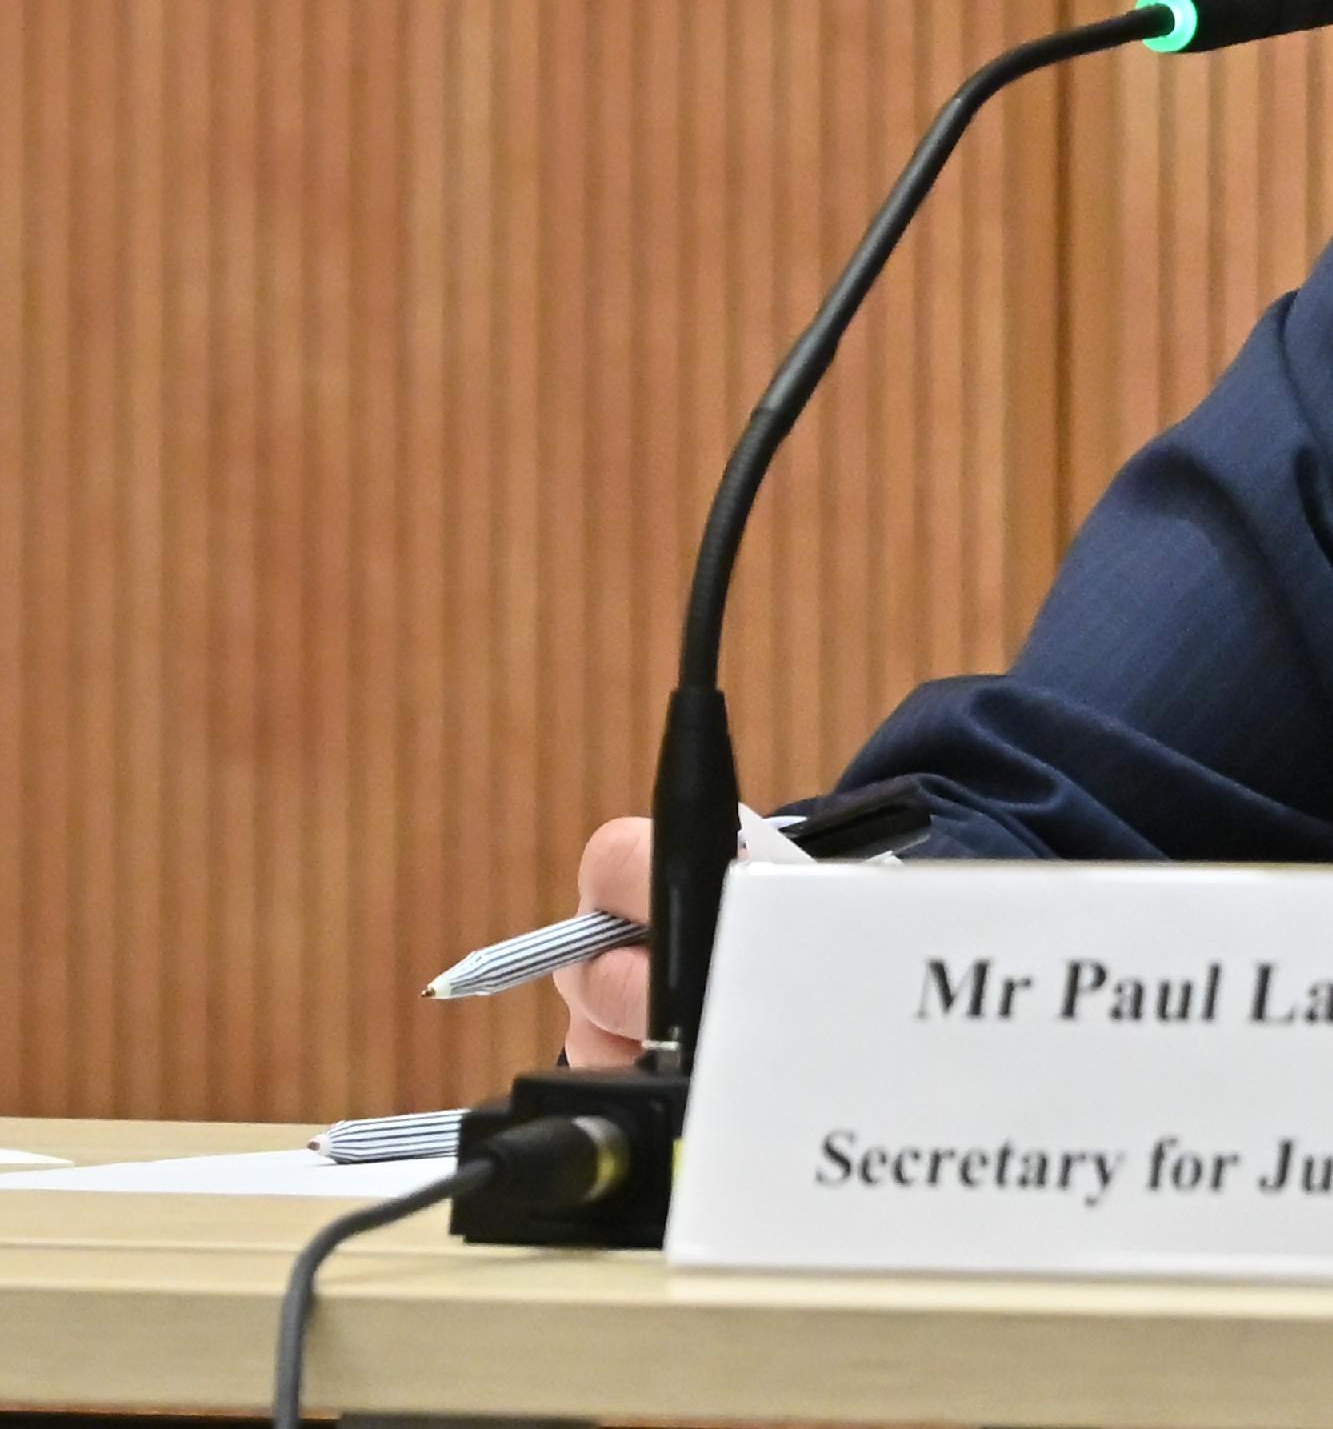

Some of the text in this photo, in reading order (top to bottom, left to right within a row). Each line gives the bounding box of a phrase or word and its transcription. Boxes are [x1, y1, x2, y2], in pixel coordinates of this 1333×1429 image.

[915, 958, 1031, 1021] Mr
[1058, 960, 1222, 1022] Paul
[816, 1134, 1122, 1206] Secretary
[1147, 1138, 1238, 1192] for
